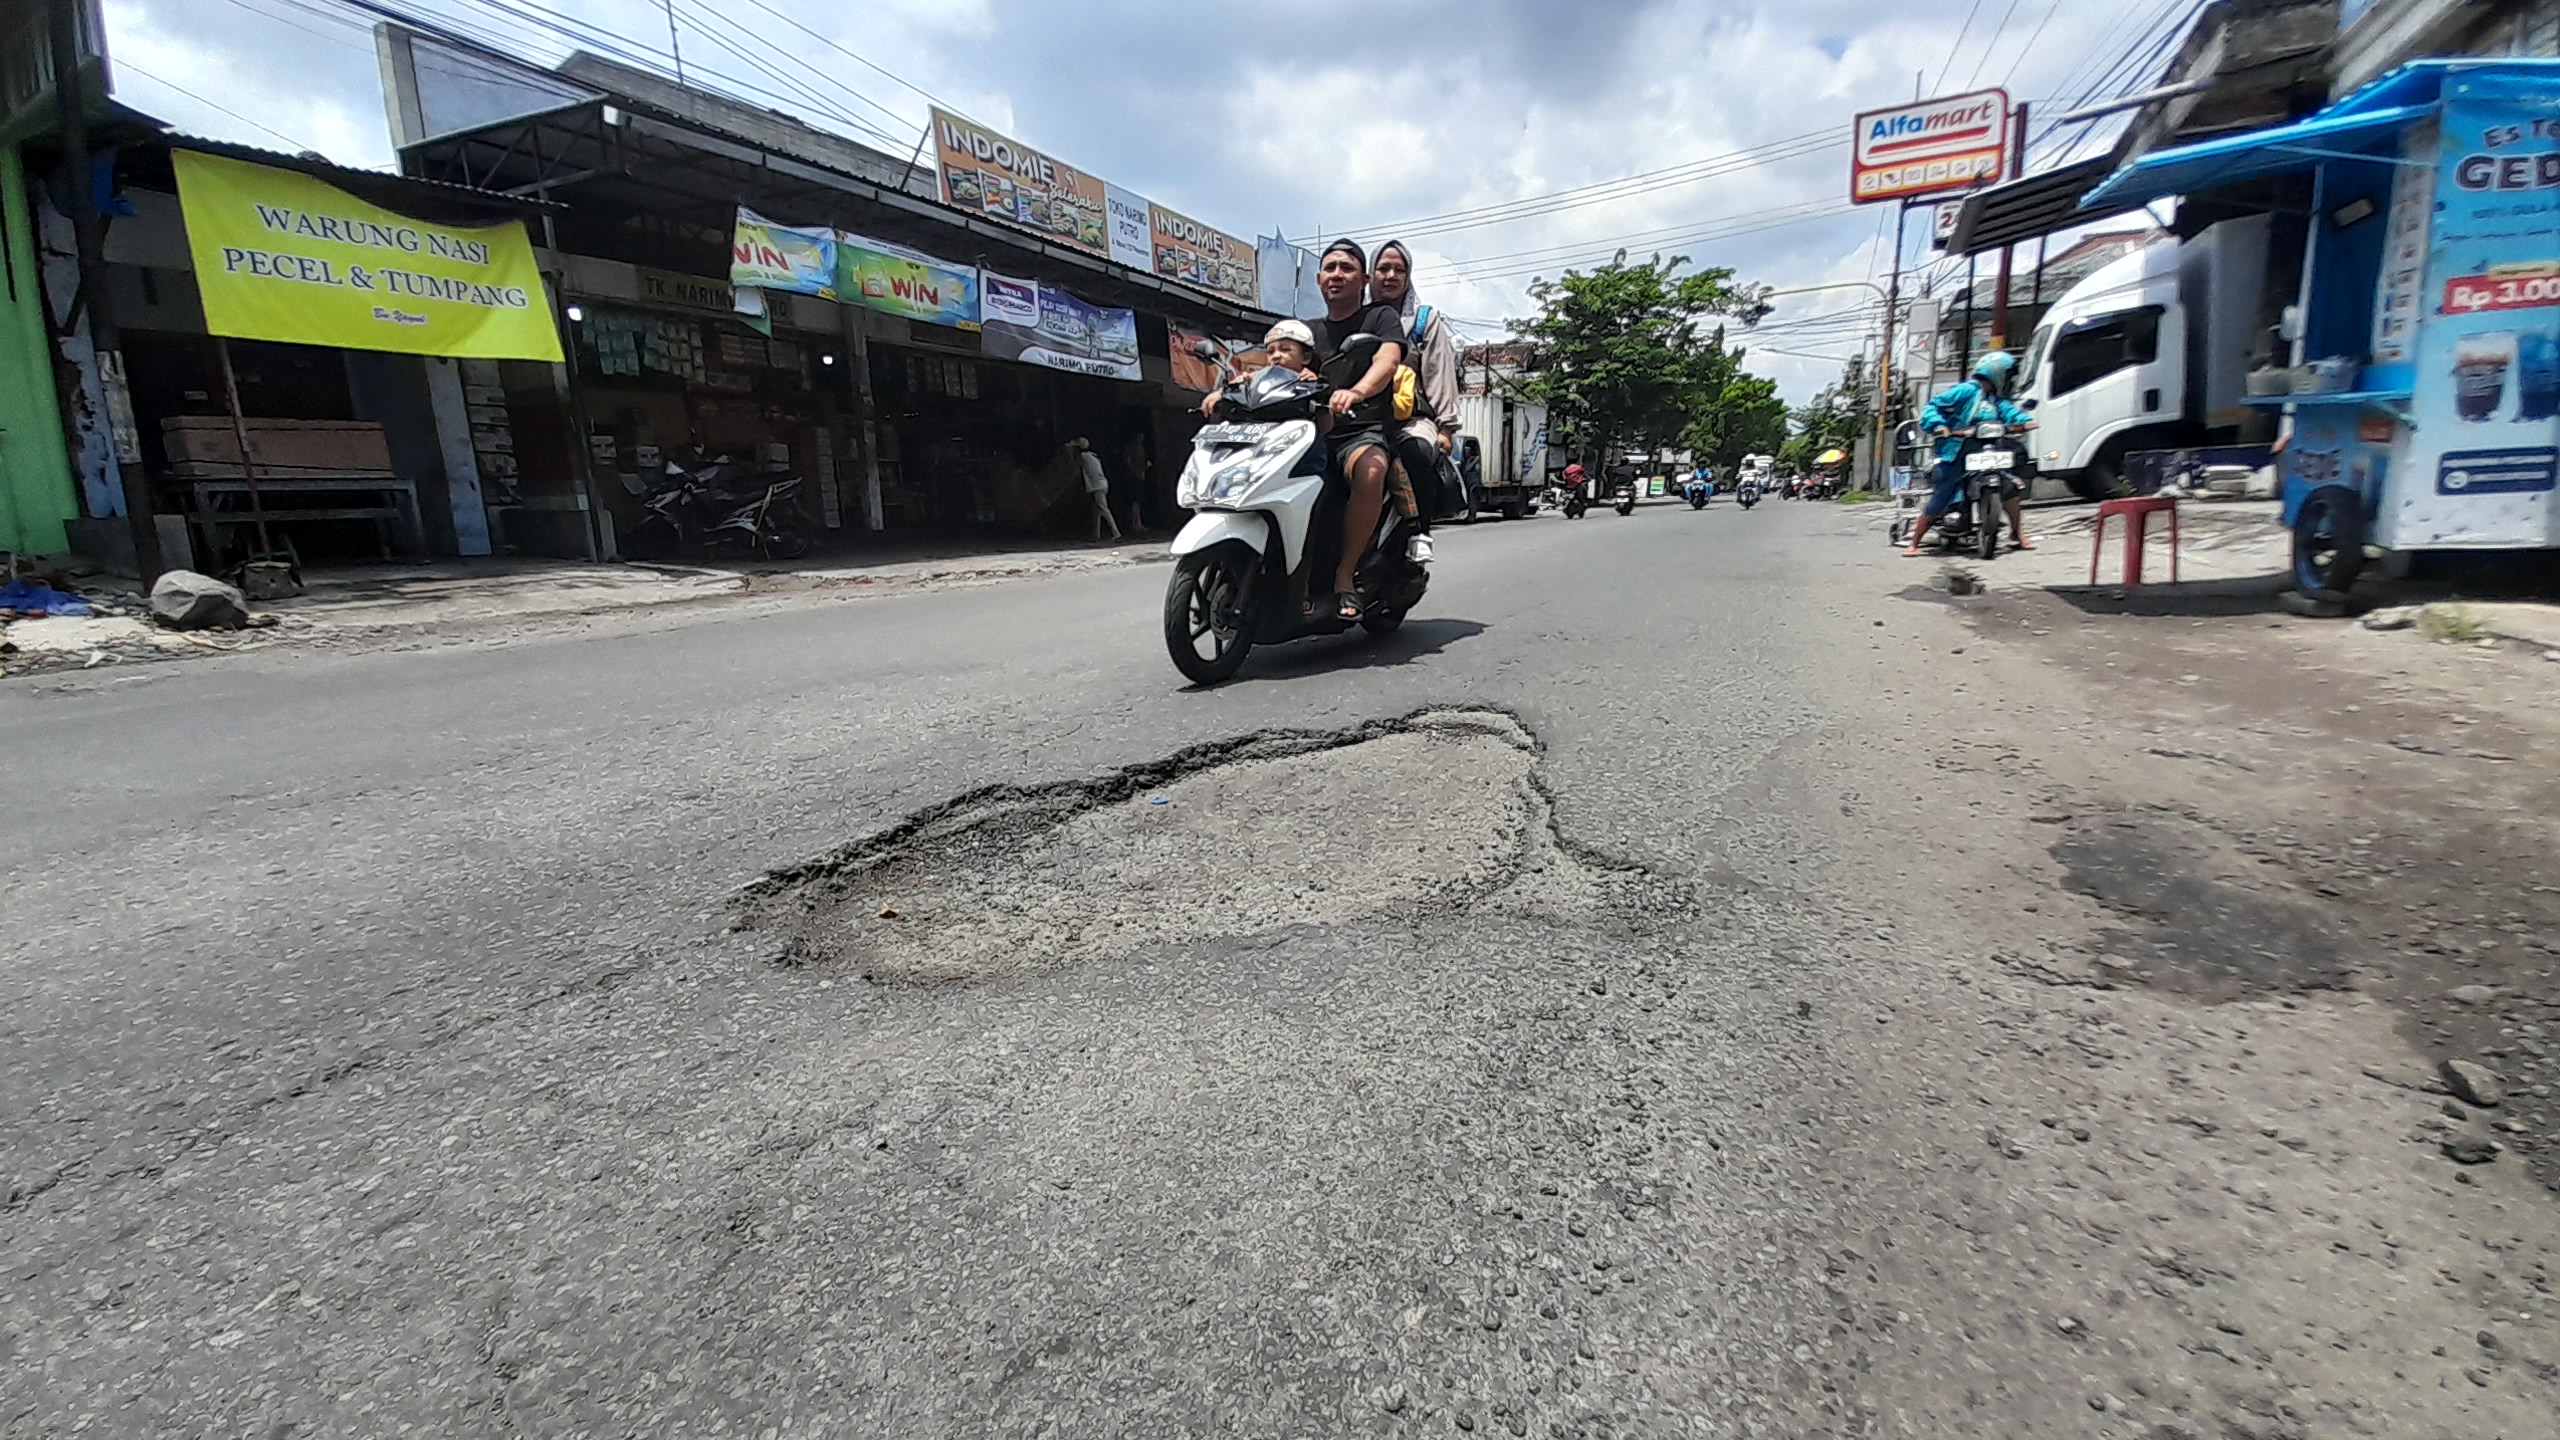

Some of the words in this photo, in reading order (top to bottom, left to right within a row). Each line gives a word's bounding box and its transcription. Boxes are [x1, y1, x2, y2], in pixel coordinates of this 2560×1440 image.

[1870, 100, 1993, 140] Alfamart
[940, 119, 1054, 184] INDOMIE
[256, 204, 419, 252] WARUNG
[426, 233, 490, 265] NASI
[1154, 211, 1223, 252] INDOMIE
[222, 247, 343, 286] PECEL
[350, 265, 375, 290] &
[380, 269, 528, 308] TUMPANG
[677, 282, 733, 309] NARIM
[2452, 286, 2493, 311] Rp
